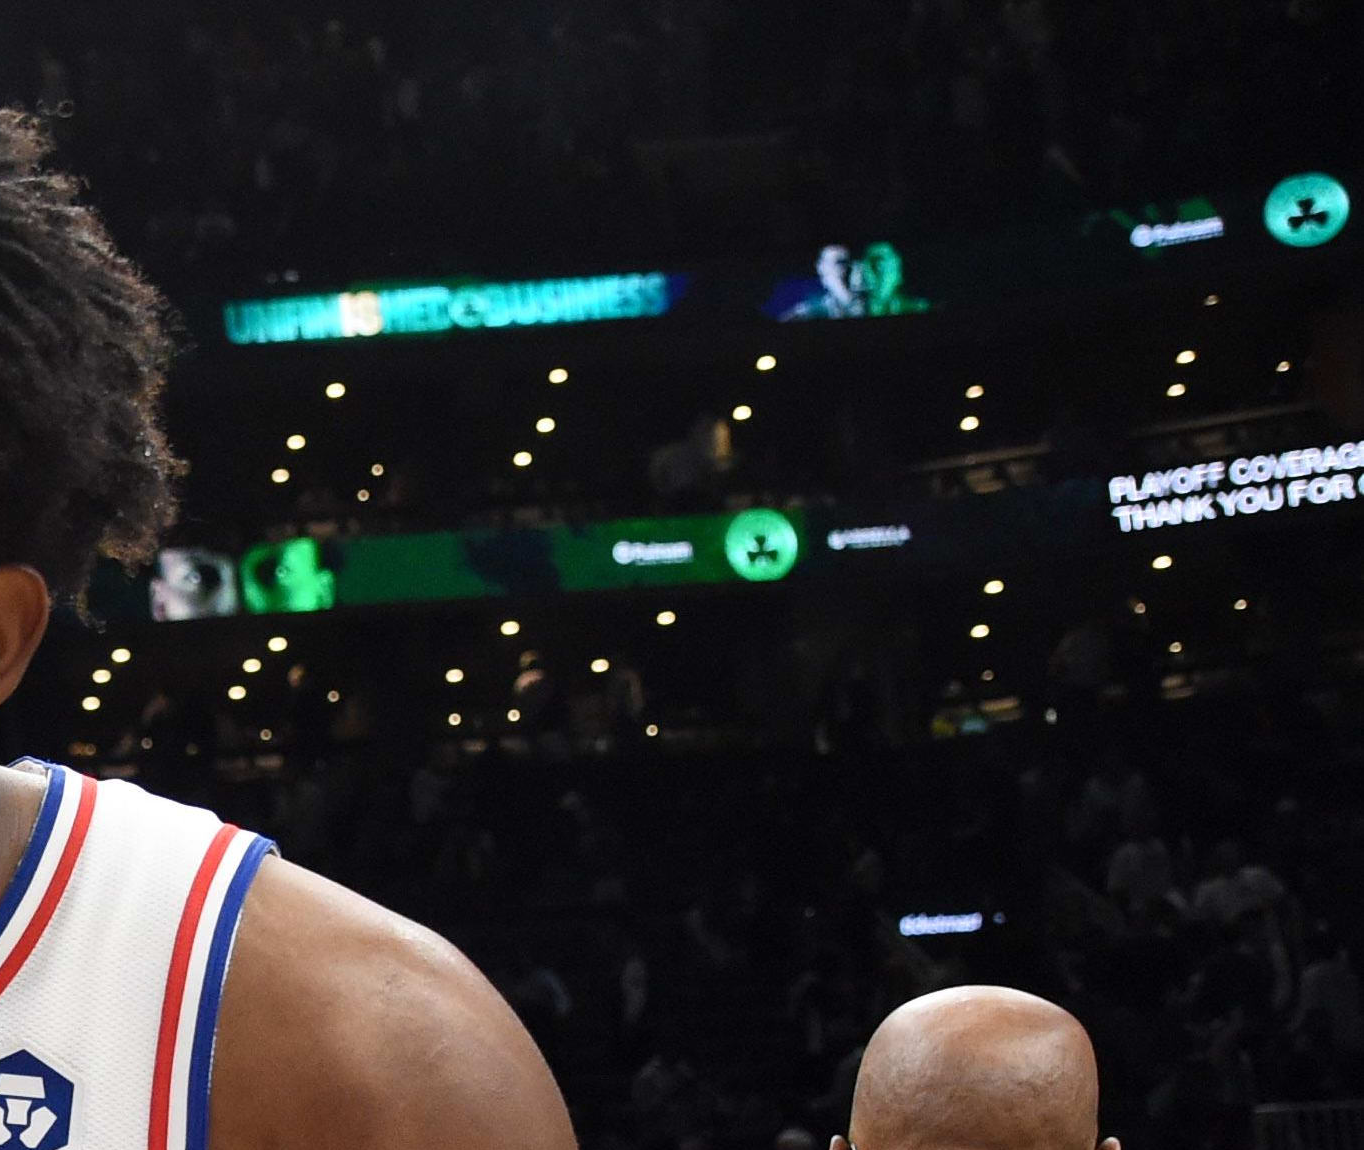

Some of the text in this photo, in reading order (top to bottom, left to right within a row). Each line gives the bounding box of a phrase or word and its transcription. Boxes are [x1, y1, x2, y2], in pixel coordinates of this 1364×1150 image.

[1109, 460, 1225, 504] PLAYOFF
[1111, 493, 1217, 533] THANK
[1216, 483, 1284, 517] YOU
[1286, 473, 1356, 508] FOR
